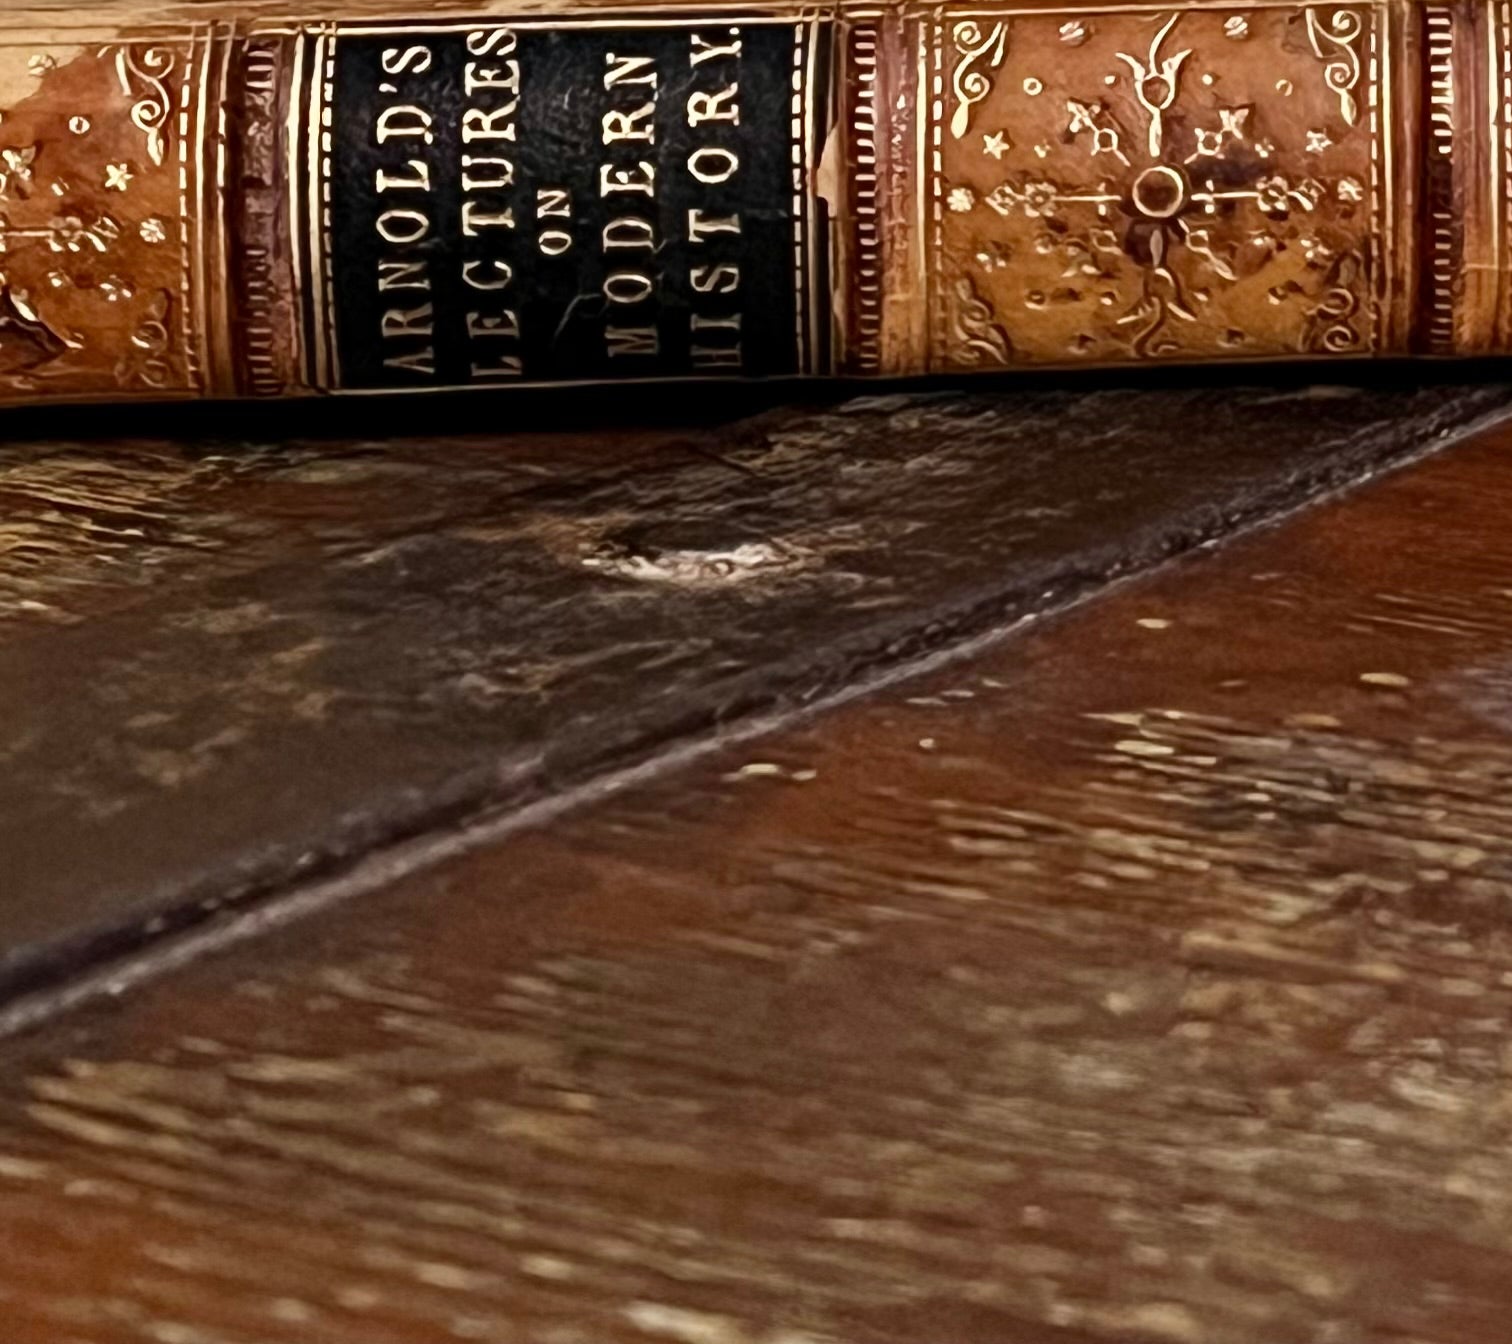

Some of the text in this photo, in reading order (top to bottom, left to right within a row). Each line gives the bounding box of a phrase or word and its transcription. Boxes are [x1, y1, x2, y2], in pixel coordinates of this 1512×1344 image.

[376, 44, 435, 374] ARNOLD'S
[461, 27, 522, 376] LECTURES
[536, 189, 571, 255] ON
[600, 52, 658, 357] MODERN
